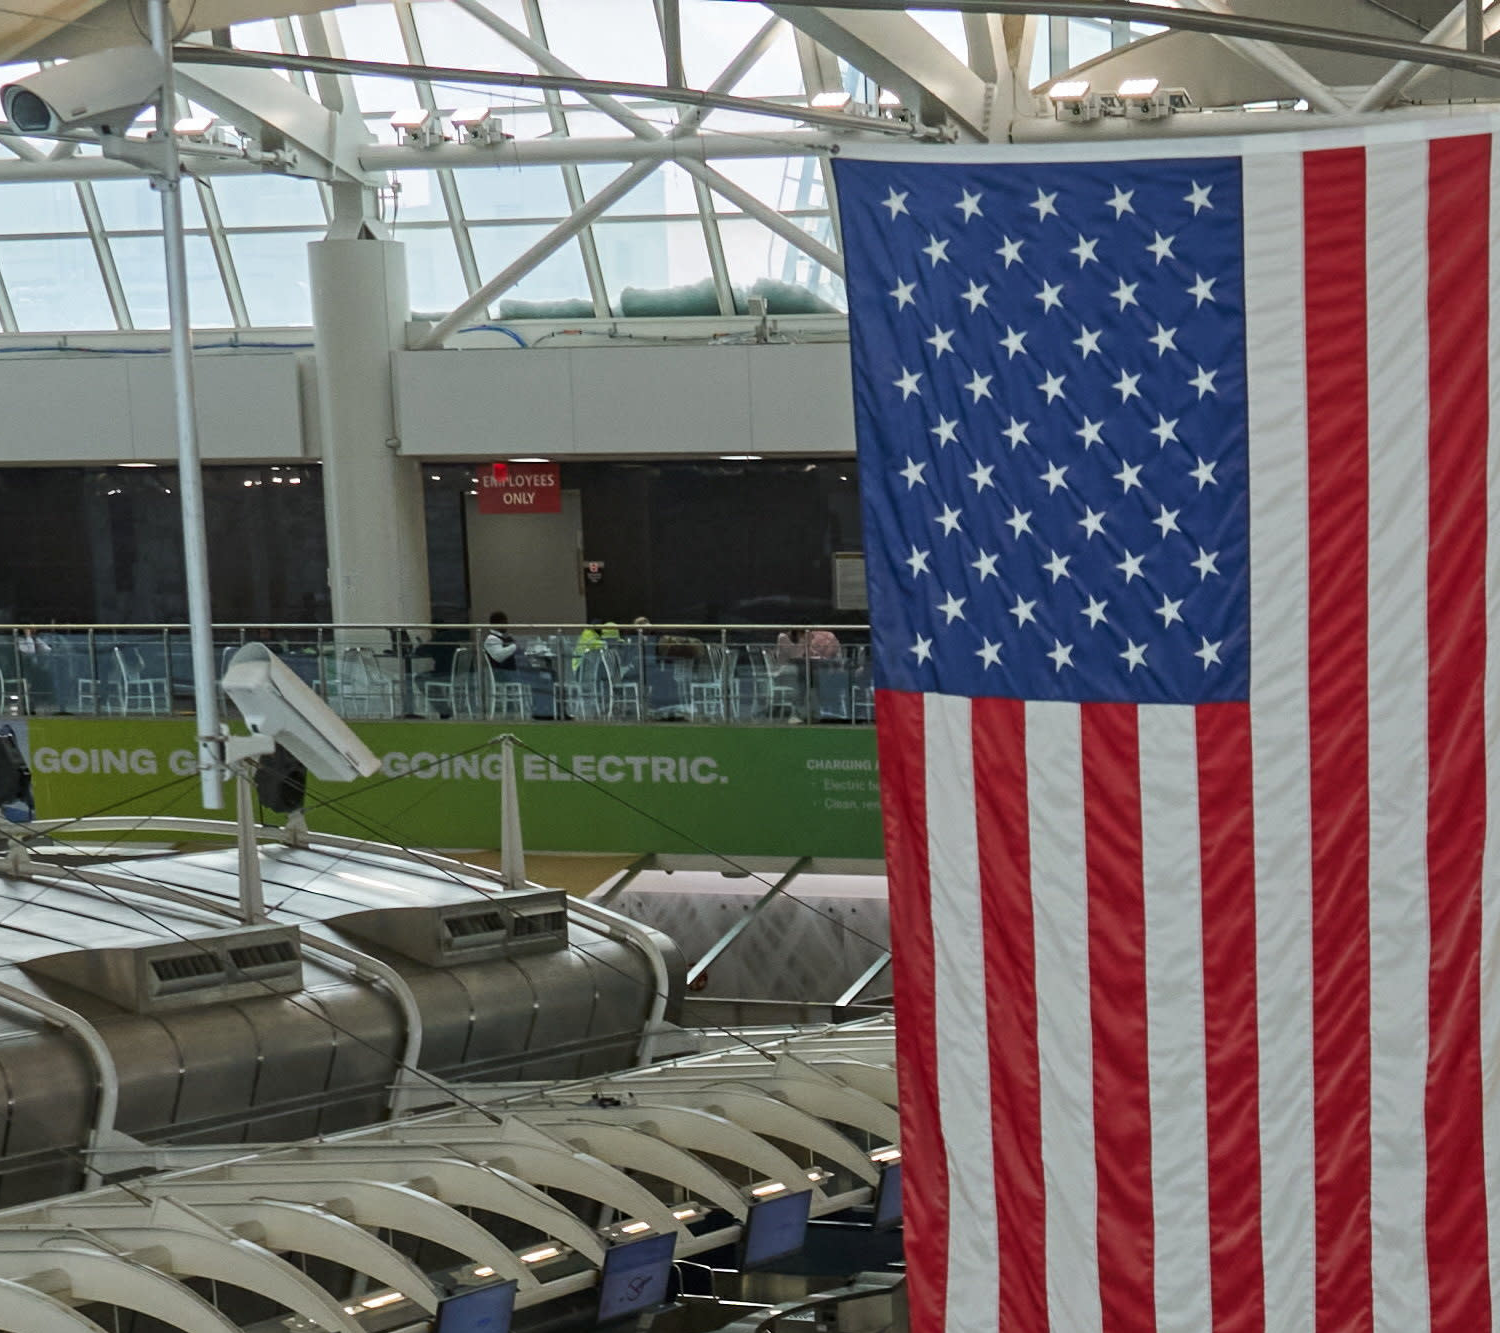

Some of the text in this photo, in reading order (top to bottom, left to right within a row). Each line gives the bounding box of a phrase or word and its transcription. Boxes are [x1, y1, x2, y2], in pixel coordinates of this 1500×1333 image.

[502, 491, 536, 505] ONLY
[33, 746, 158, 775] GOING
[381, 751, 729, 785] GOING ELECTRIC.
